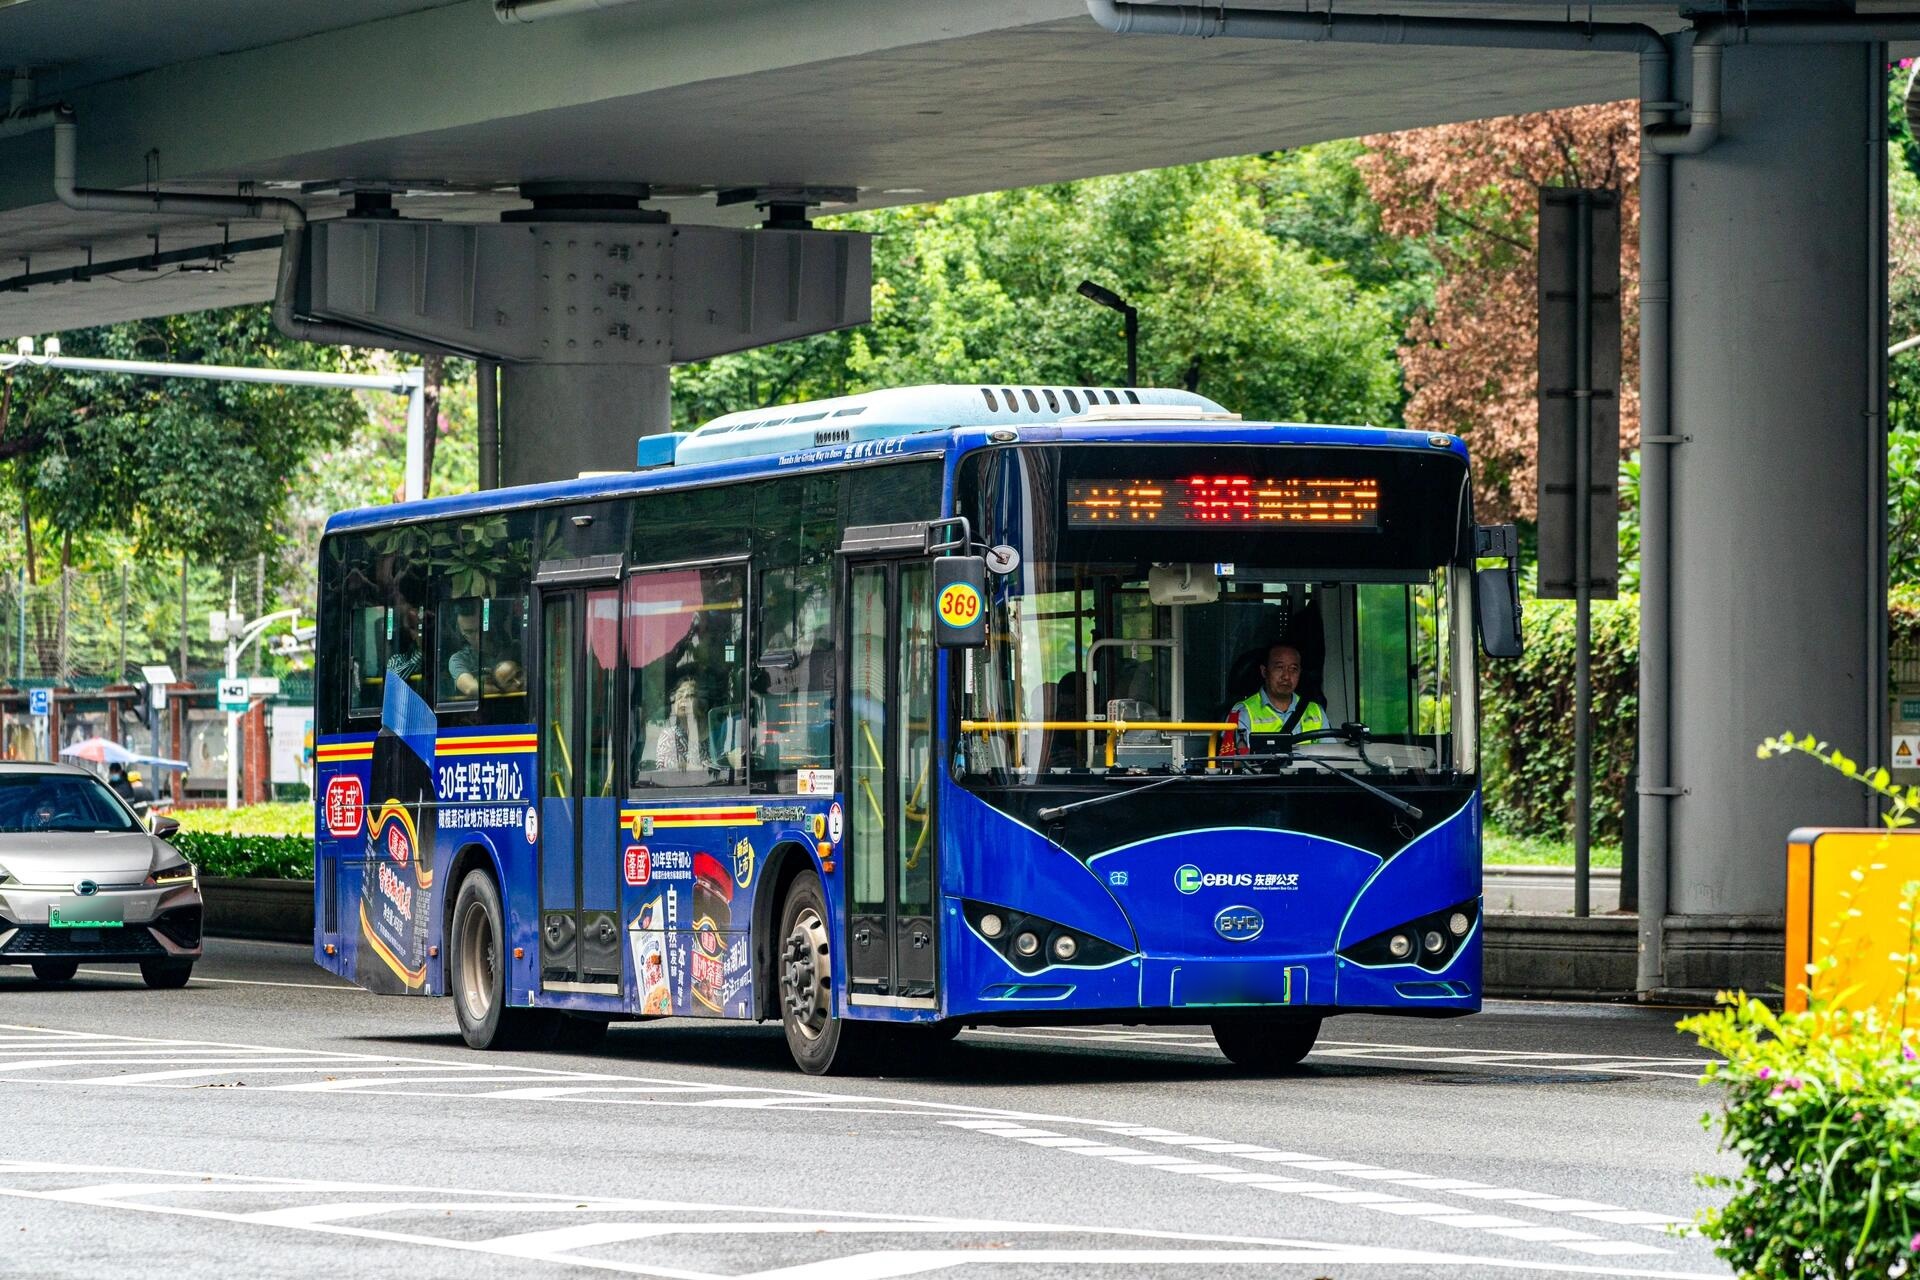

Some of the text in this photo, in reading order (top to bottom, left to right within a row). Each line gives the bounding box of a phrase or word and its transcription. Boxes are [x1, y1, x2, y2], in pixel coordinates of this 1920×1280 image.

[778, 454, 794, 466] Thanks
[943, 592, 977, 617] 369
[438, 760, 523, 802] 30年坚守初心
[330, 784, 358, 828] 蓬盛
[528, 815, 535, 832] 下
[832, 817, 840, 835] 上
[651, 850, 692, 869] 30年坚守初心
[1253, 873, 1299, 886] 东部公交
[1220, 916, 1259, 931] BYD
